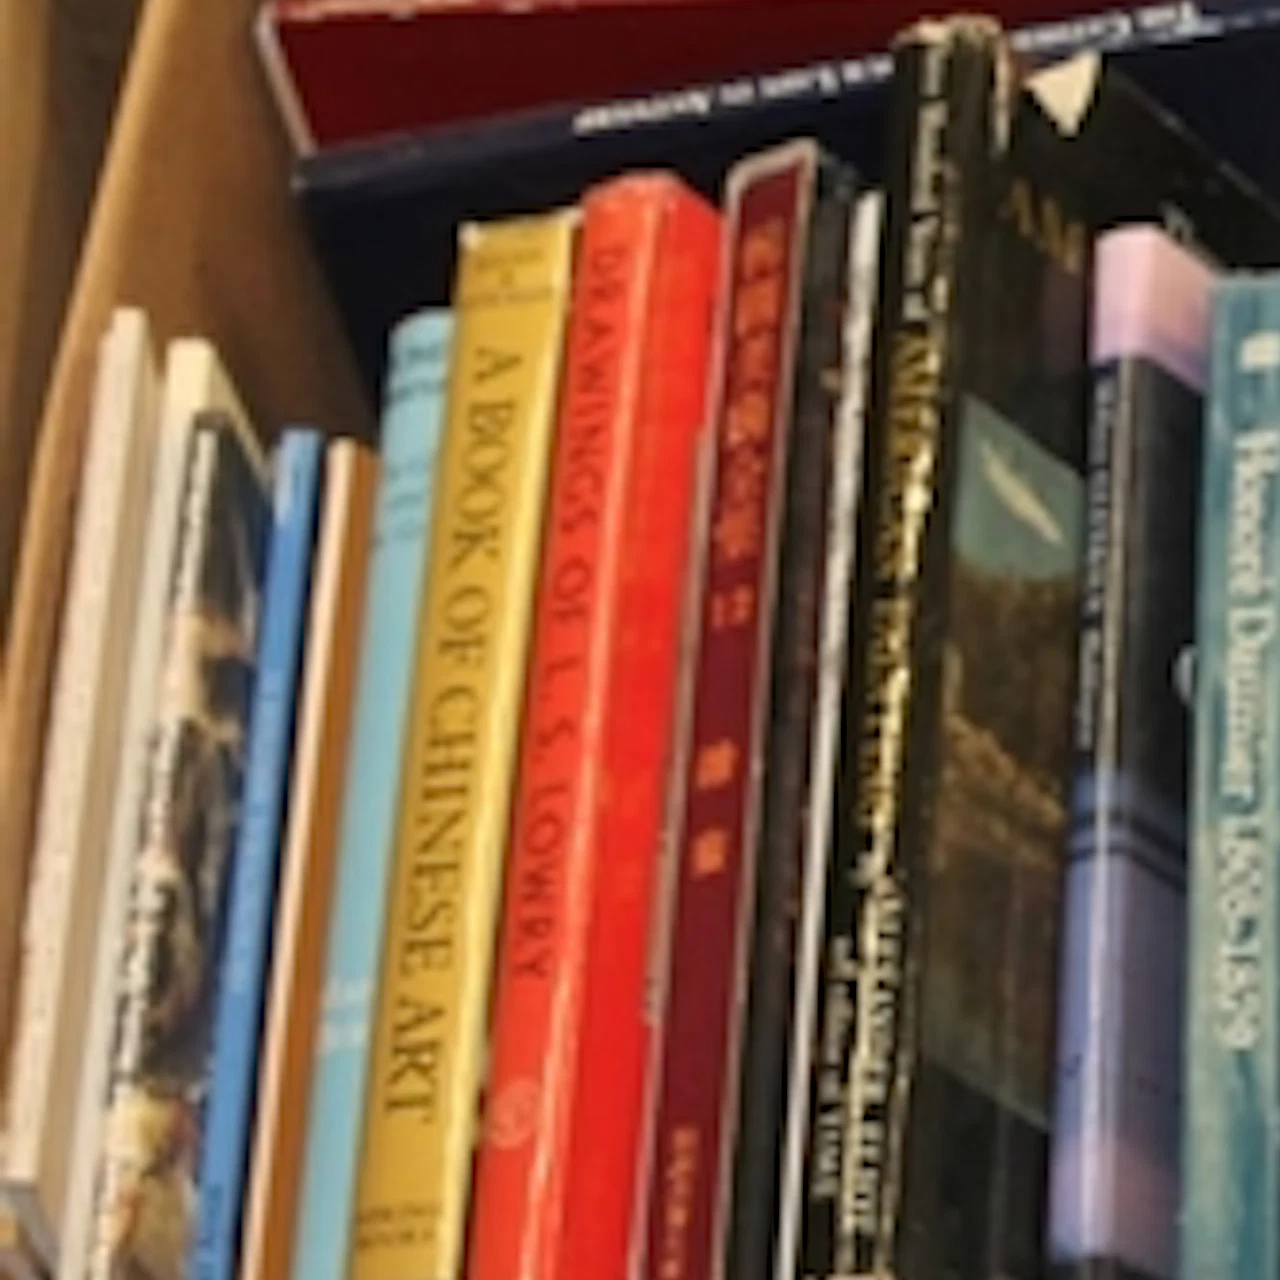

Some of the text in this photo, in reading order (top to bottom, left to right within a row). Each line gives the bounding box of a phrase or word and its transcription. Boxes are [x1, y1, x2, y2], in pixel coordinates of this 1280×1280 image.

[471, 345, 523, 386] A
[555, 242, 630, 537] DRAWINGS
[444, 398, 513, 573] BOOK
[440, 584, 494, 667] OF
[548, 556, 593, 625] OF
[400, 679, 482, 975] CHINESE
[1212, 427, 1280, 1053] Honoré Daumier 1808-1879
[514, 781, 569, 984] LOWRY
[381, 990, 449, 1127] ART
